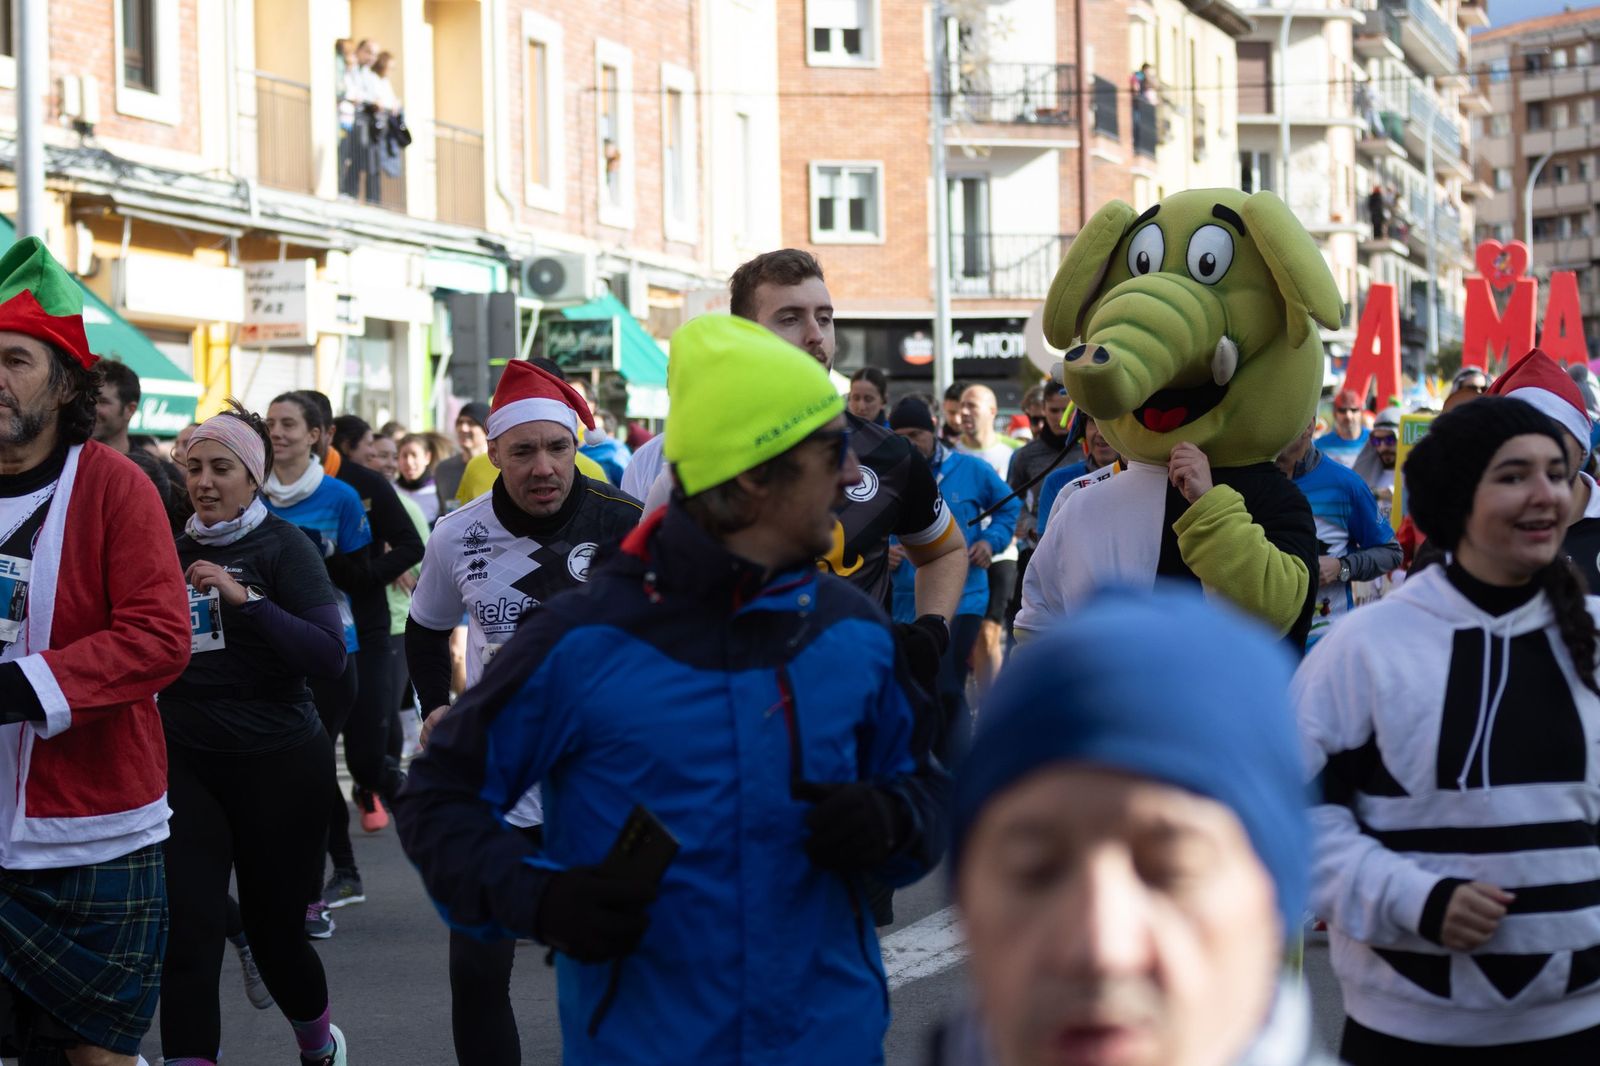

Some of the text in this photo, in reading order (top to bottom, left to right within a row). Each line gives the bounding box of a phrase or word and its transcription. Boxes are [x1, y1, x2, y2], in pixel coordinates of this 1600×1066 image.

[252, 297, 284, 314] Paz
[973, 331, 1025, 359] ANTON
[475, 596, 541, 623] telef
